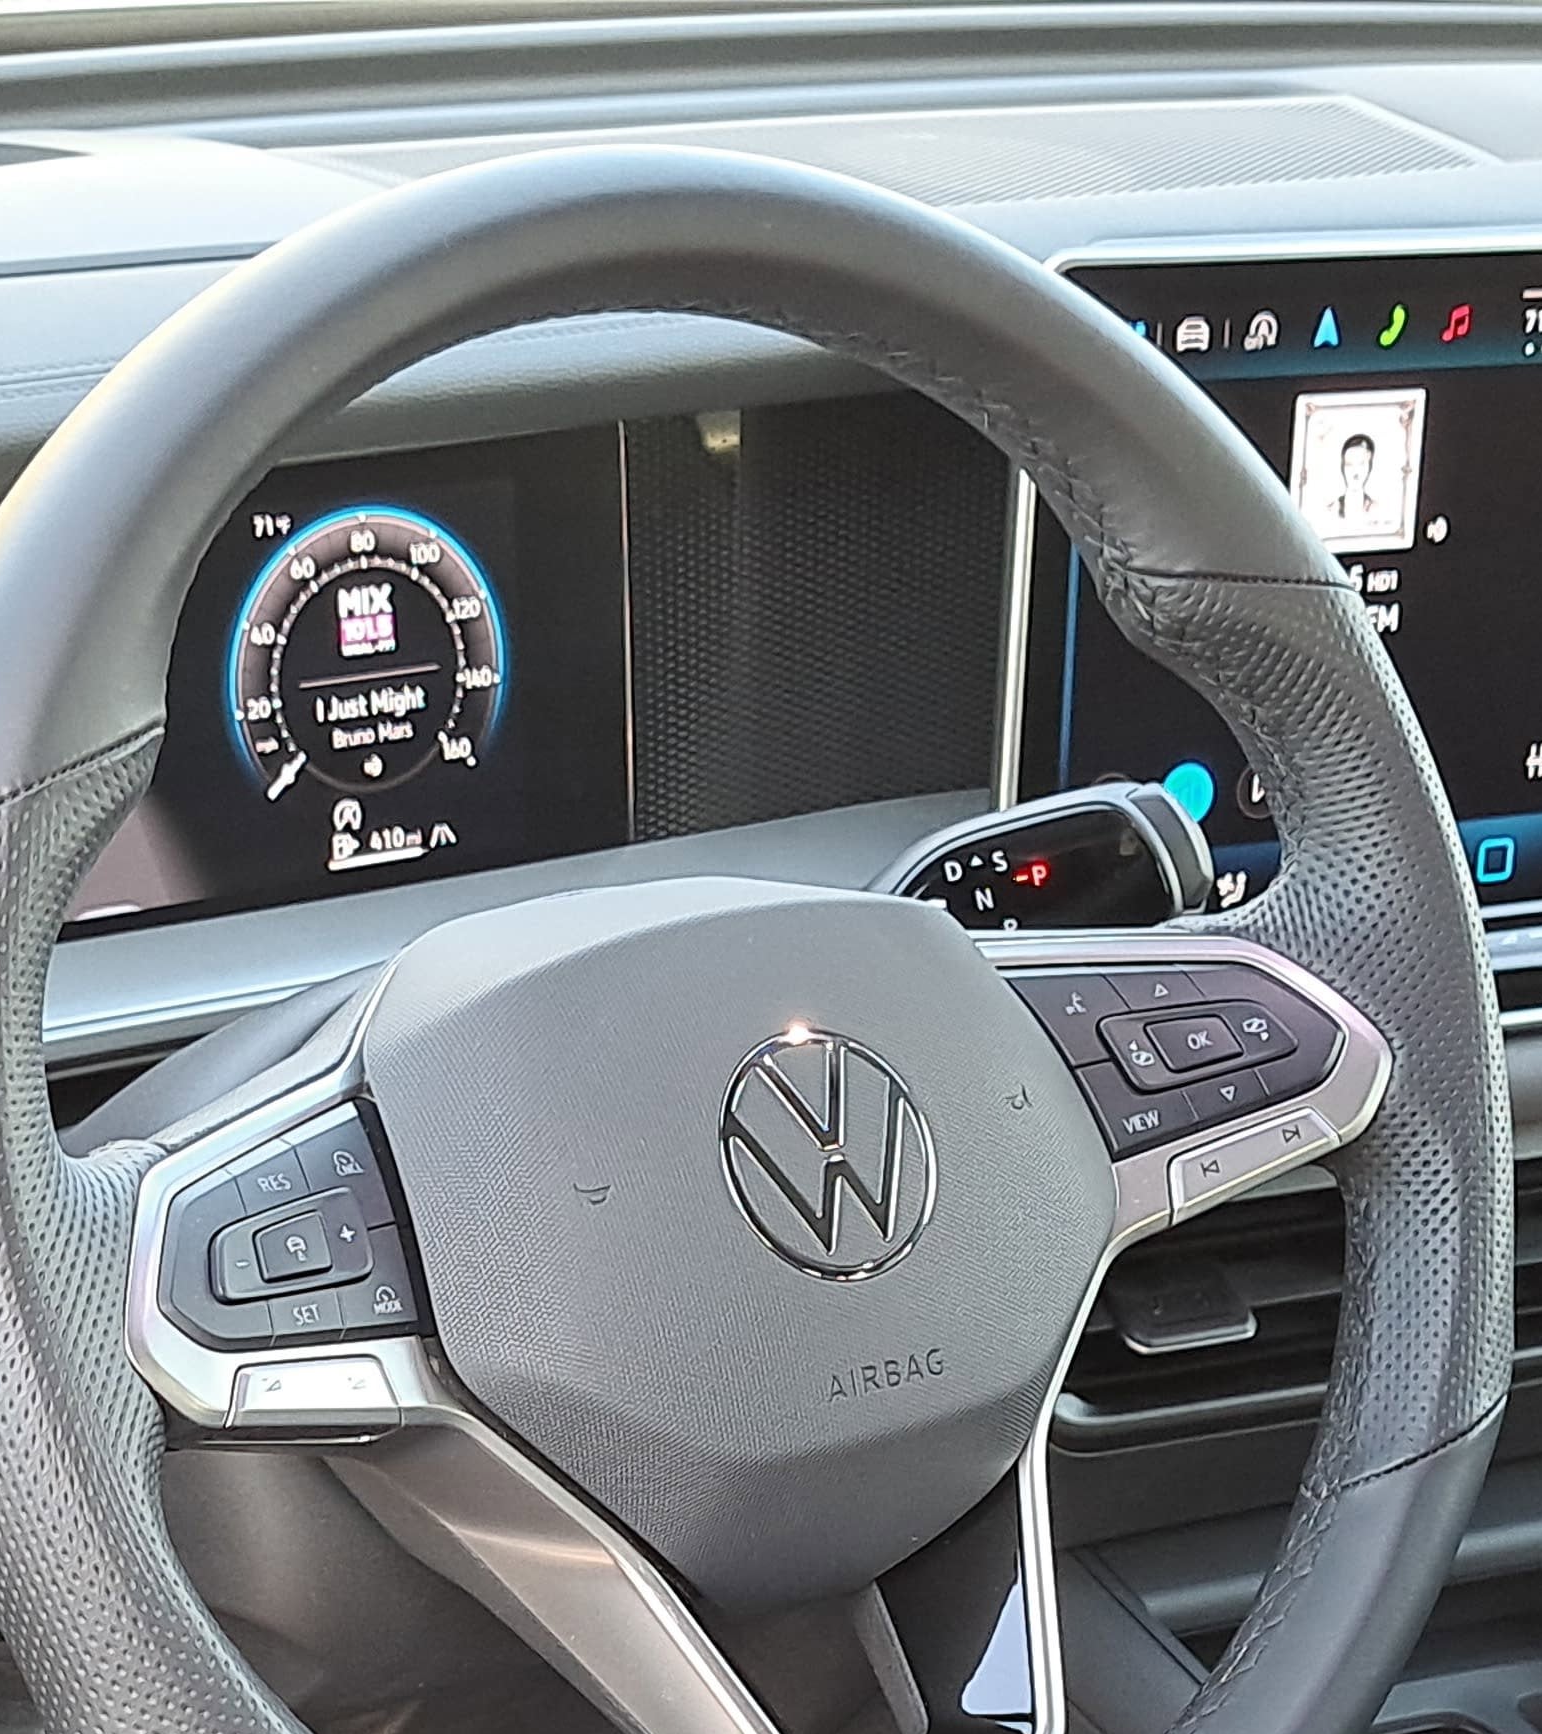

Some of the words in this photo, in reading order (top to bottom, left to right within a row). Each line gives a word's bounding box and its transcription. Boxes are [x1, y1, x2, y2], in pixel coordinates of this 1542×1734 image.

[350, 531, 375, 553] 80
[410, 542, 441, 565] 100
[290, 555, 316, 580] 60
[338, 583, 394, 618] MIX
[452, 595, 482, 619] 120
[250, 623, 276, 645] 40
[464, 664, 492, 690] 140
[247, 696, 272, 720] 20
[327, 693, 369, 722] Just
[370, 683, 427, 717] Might
[332, 727, 375, 750] Bruno
[377, 719, 414, 744] Mars
[943, 859, 962, 883] D
[991, 849, 1008, 873] S
[1032, 864, 1048, 885] P
[974, 887, 995, 911] N
[1187, 1030, 1214, 1051] OK
[1121, 1109, 1160, 1136] VIEW
[256, 1173, 292, 1193] RES
[292, 1303, 321, 1325] SET
[828, 1347, 947, 1402] AIRBAG
